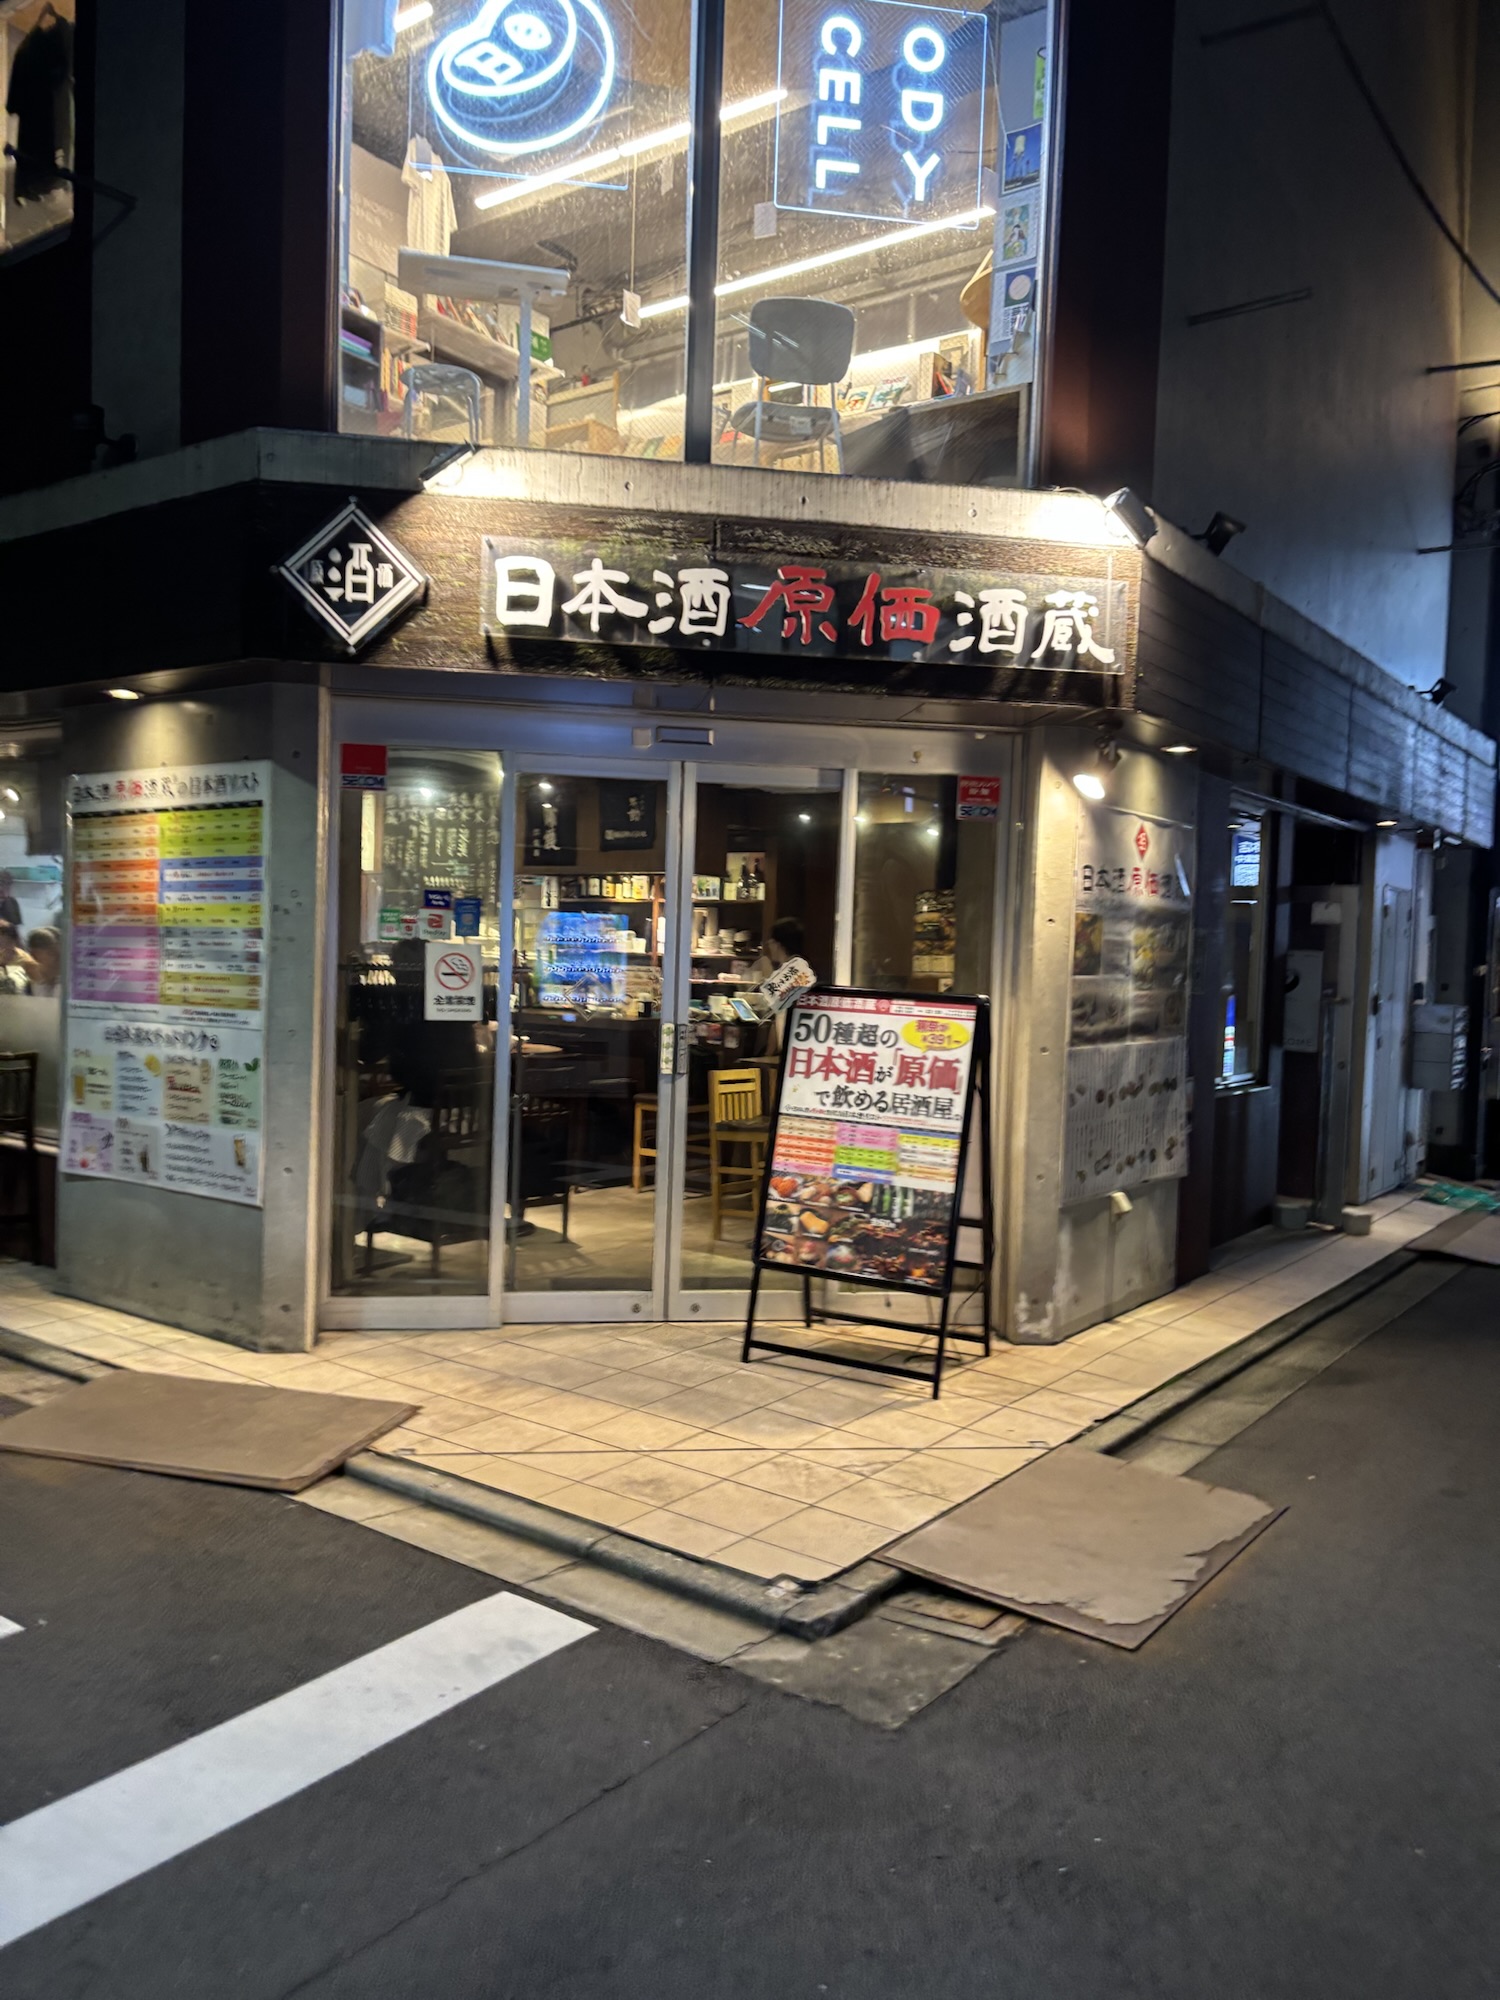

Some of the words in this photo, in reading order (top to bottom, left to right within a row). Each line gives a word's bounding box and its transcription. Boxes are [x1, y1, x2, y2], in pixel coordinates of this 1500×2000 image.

[816, 16, 862, 189] CELL
[495, 555, 1115, 664] 日本酒原価酒蔵
[342, 775, 385, 787] SECOM
[794, 1012, 899, 1049] 50種超の
